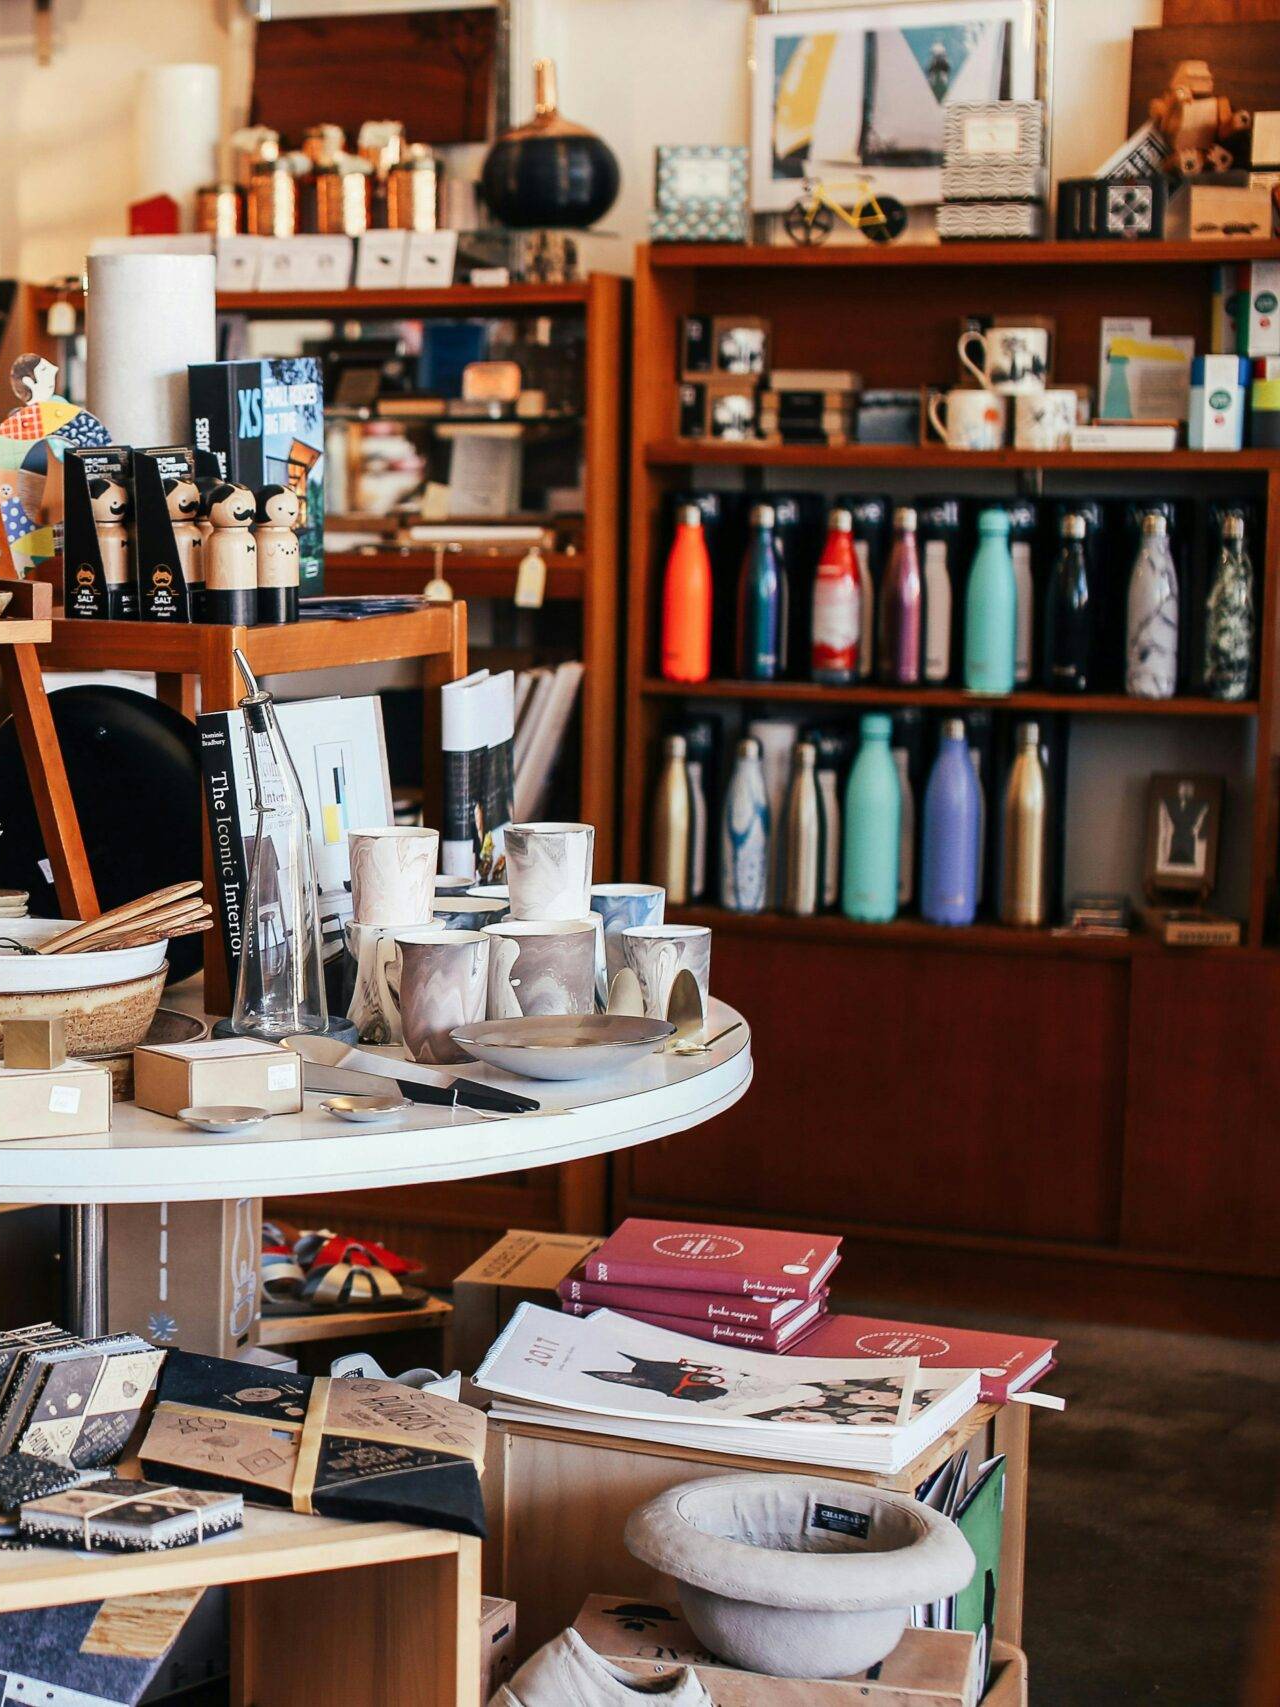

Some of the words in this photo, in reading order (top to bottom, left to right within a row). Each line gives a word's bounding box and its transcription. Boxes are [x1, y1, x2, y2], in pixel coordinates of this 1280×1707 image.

[238, 388, 263, 438] XS
[154, 596, 172, 604] SALT
[202, 739, 226, 747] Bradbury
[211, 771, 227, 810] The
[217, 818, 240, 876] Iconic
[225, 882, 242, 957] Interior
[598, 1263, 608, 1281] 2017
[571, 1281, 581, 1300] 2017
[524, 1337, 560, 1367] 2017
